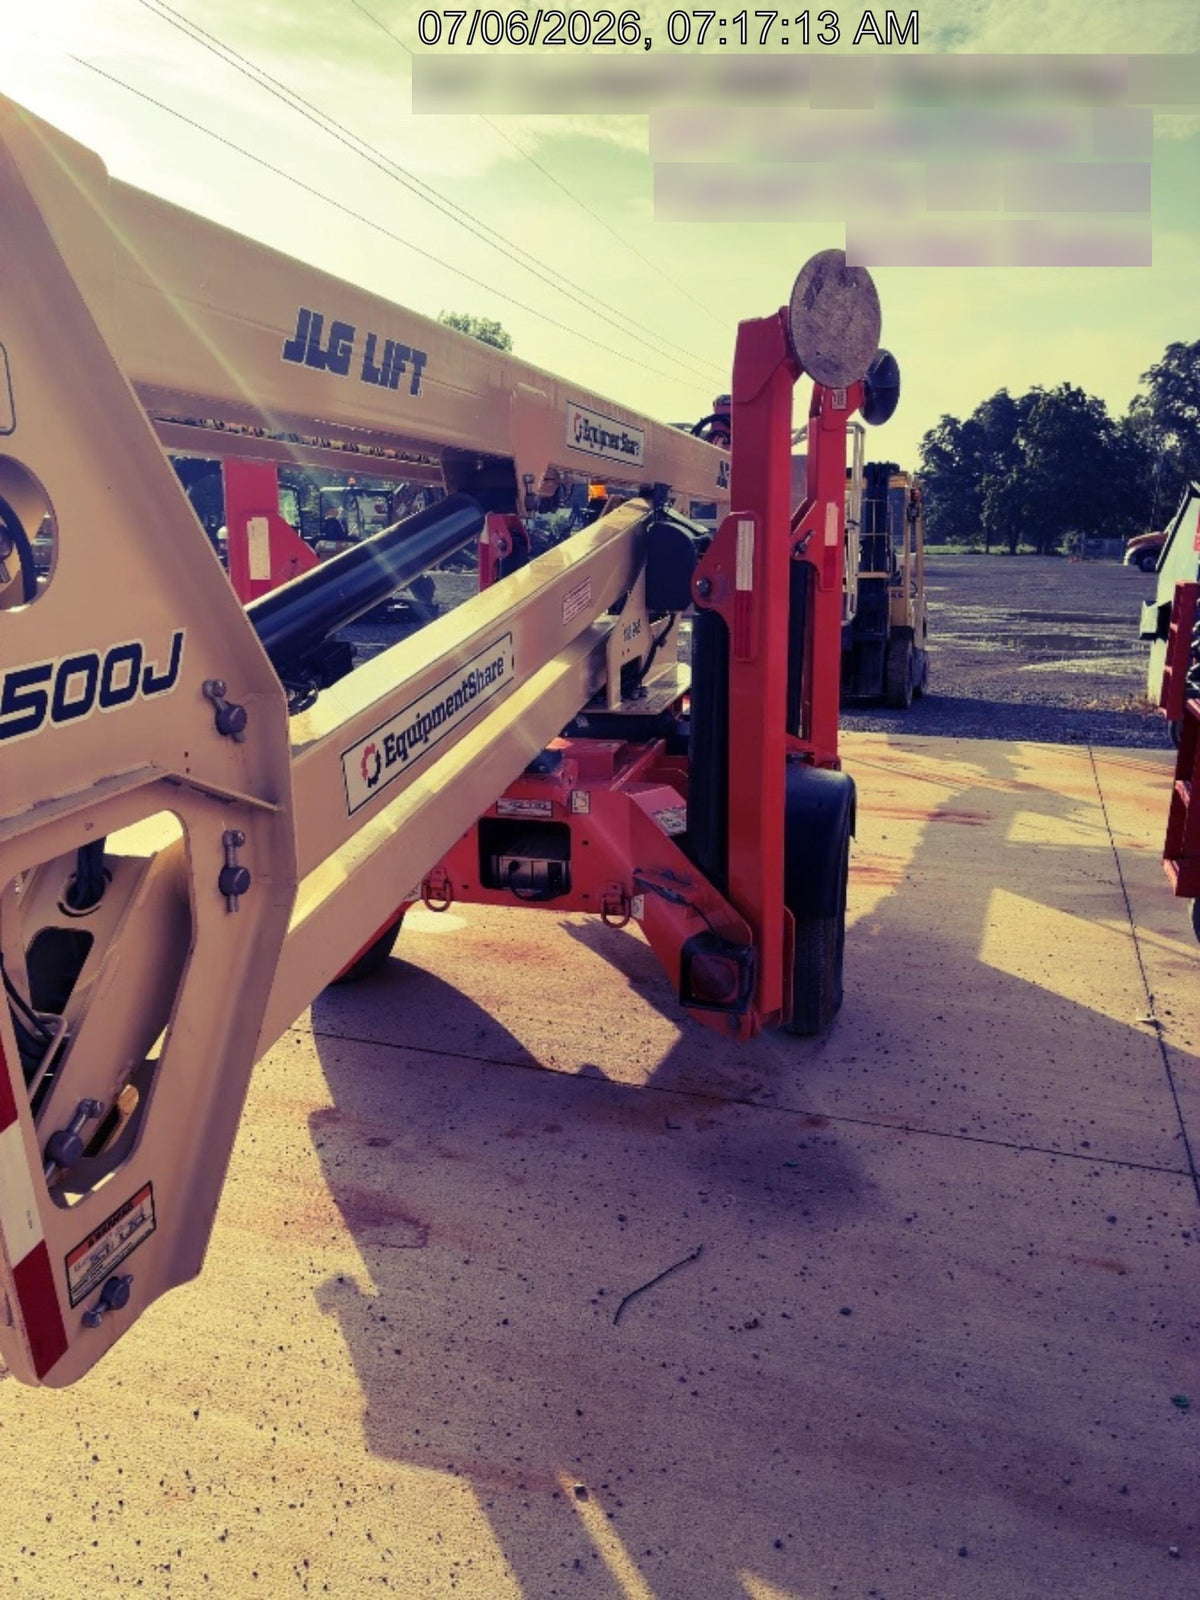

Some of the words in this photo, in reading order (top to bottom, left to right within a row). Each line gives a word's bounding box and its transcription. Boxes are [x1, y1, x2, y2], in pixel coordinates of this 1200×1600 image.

[282, 306, 356, 377] JLG
[361, 332, 428, 397] LIFT
[0, 631, 185, 742] 500J
[383, 655, 505, 769] EquipmentShare
